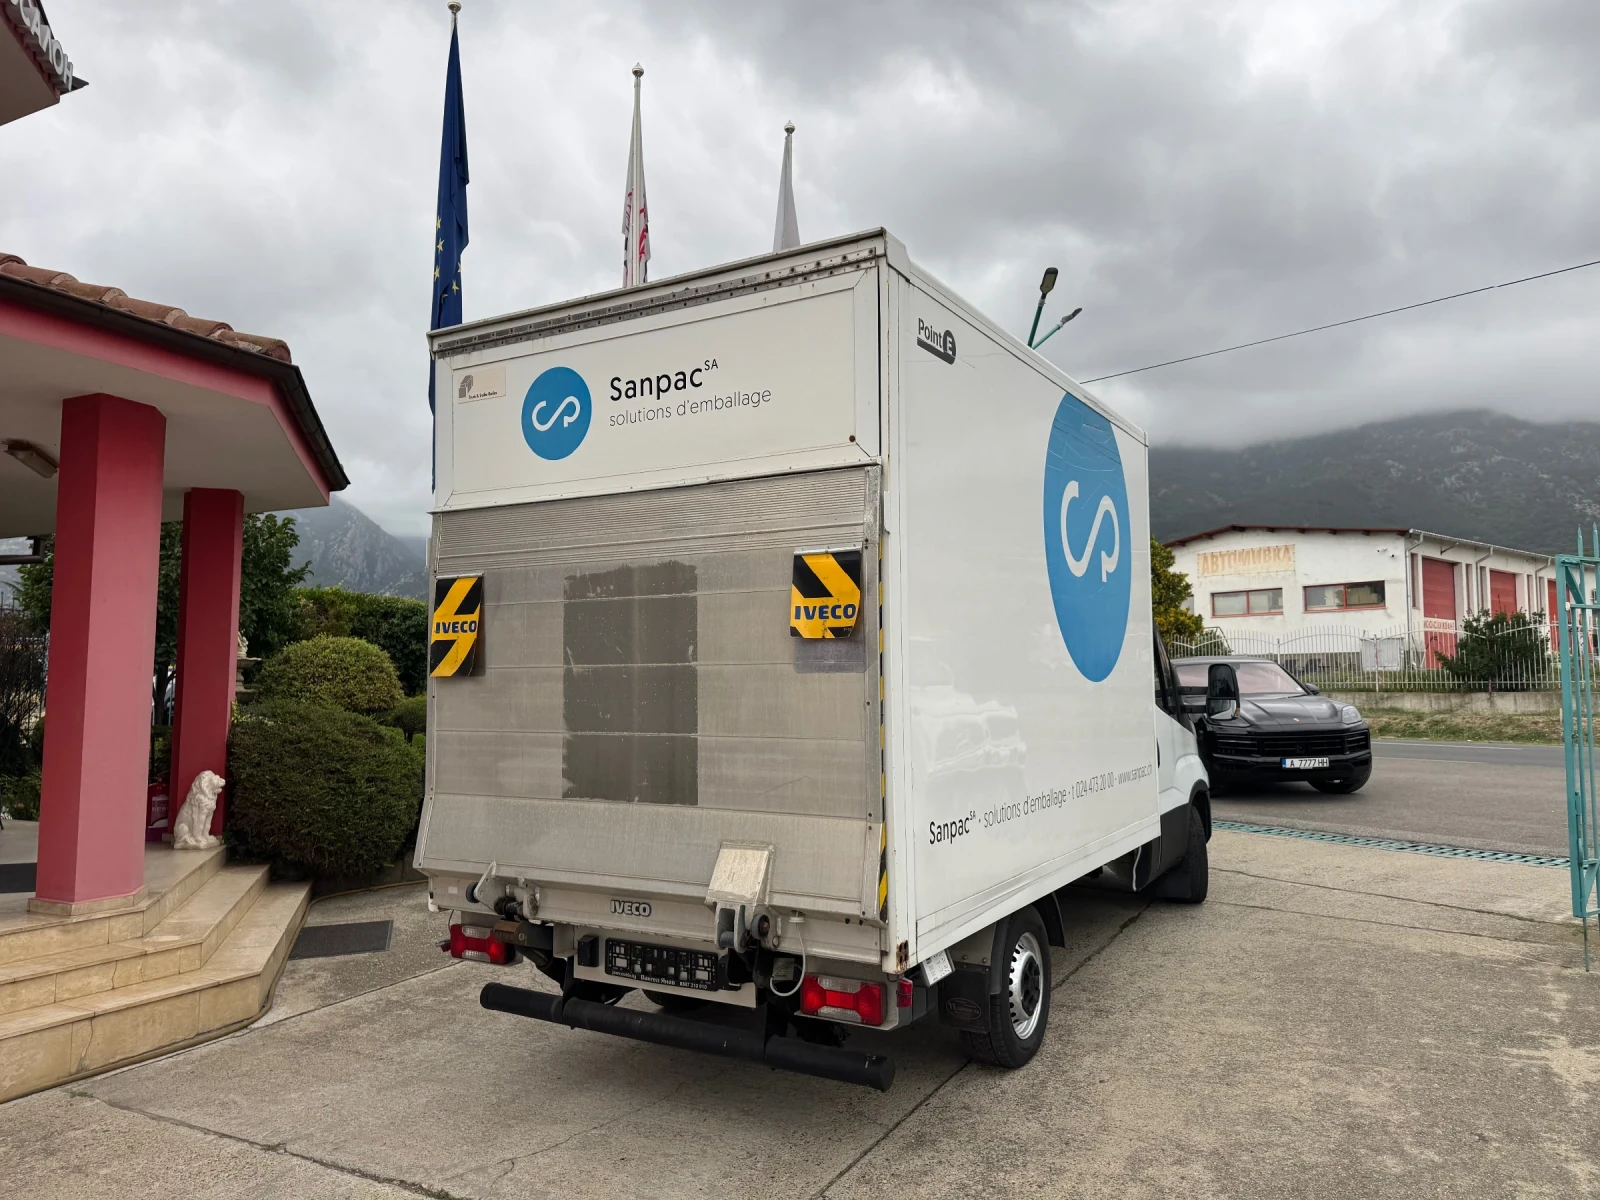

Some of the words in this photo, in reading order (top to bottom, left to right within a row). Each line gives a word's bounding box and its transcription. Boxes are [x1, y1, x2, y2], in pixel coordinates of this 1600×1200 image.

[11, 0, 73, 91] САЛОН
[918, 317, 942, 348] Point
[610, 368, 703, 401] Sanpac
[609, 405, 672, 426] solutions
[676, 390, 772, 416] d'emballage
[1202, 546, 1292, 574] АВТОМИВКА
[435, 620, 477, 633] IVECO
[794, 603, 857, 620] IVECO
[929, 817, 969, 845] Sanpac
[984, 802, 1021, 828] solutions
[1023, 788, 1067, 816] d'emballage
[1076, 780, 1088, 799] 024
[1088, 776, 1099, 793] 473
[1100, 774, 1107, 791] 20
[1108, 772, 1114, 788] 00
[1118, 761, 1153, 784] www.sanpac.ch
[610, 900, 652, 917] IVECO
